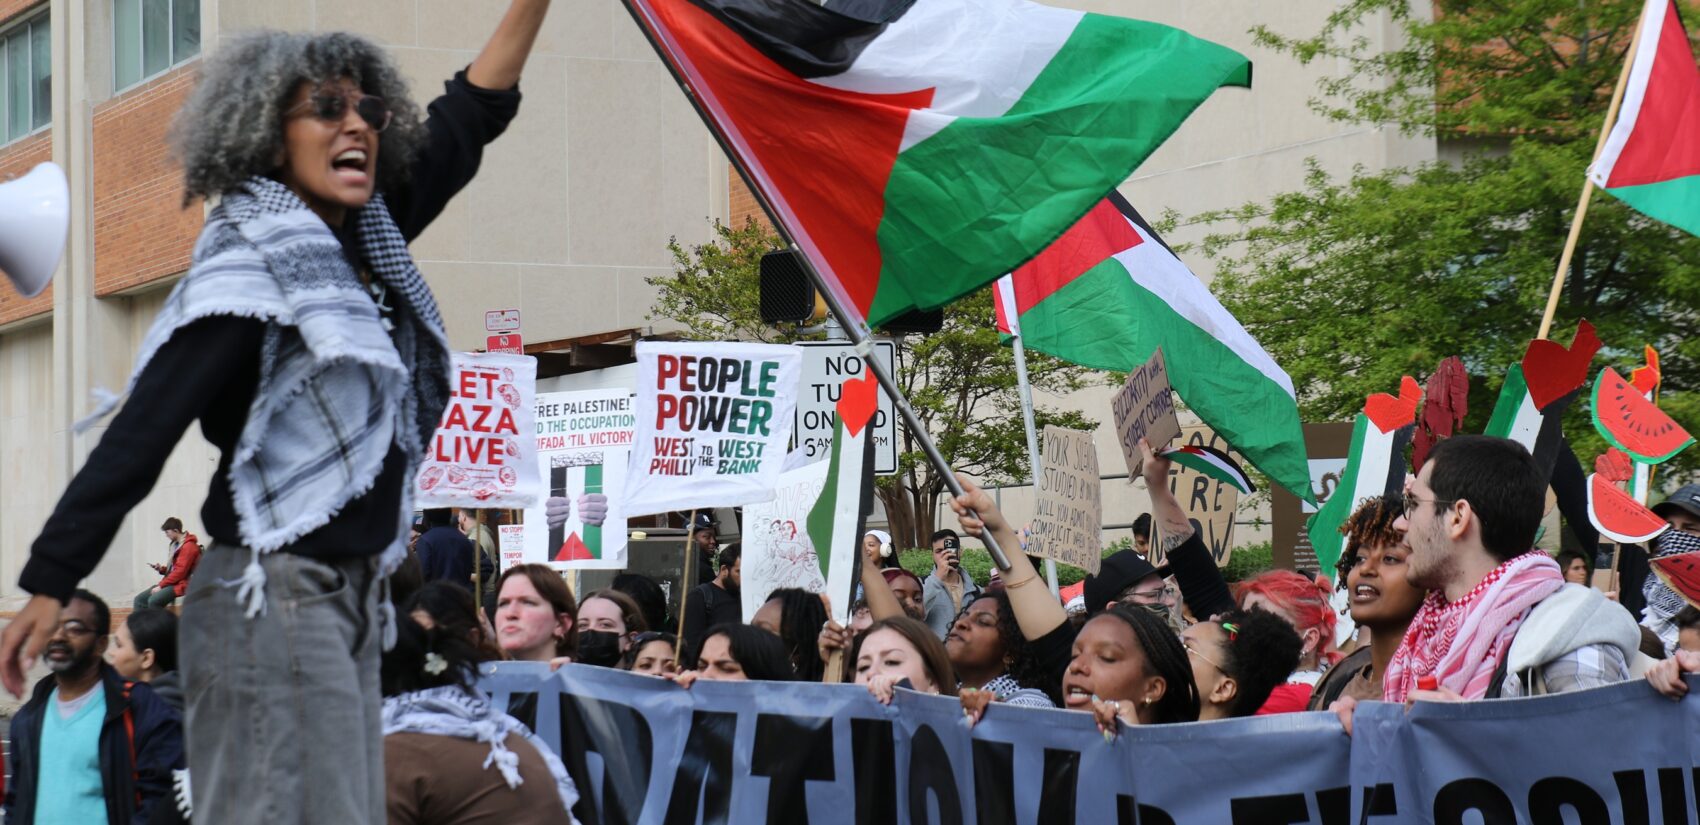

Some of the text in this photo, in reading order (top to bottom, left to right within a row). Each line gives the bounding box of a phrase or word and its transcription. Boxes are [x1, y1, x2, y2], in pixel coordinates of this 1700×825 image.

[657, 354, 780, 397] PEOPLE
[825, 356, 862, 376] NO
[451, 371, 499, 400] ET
[811, 383, 842, 402] TU
[563, 398, 630, 415] PALESTINE!
[656, 394, 773, 437] POWER
[437, 403, 519, 435] AZA
[547, 419, 567, 433] THE
[569, 414, 636, 431] OCCUPATION
[436, 434, 504, 465] LIVE
[536, 436, 565, 449] IFADA
[589, 431, 634, 445] VICTORY
[654, 437, 695, 458] WEST
[701, 445, 713, 456] TO
[718, 439, 767, 459] WEST
[1046, 431, 1069, 467] YOUR
[649, 458, 697, 476] PHILLY
[698, 455, 714, 467] THE
[716, 458, 762, 475] BANK
[1042, 466, 1077, 501] STUDIED
[1036, 498, 1054, 517] WILL
[1057, 503, 1069, 523] YOU
[1031, 518, 1072, 545] COMPLICIT
[1026, 536, 1046, 557] HOW
[1048, 541, 1059, 559] THE
